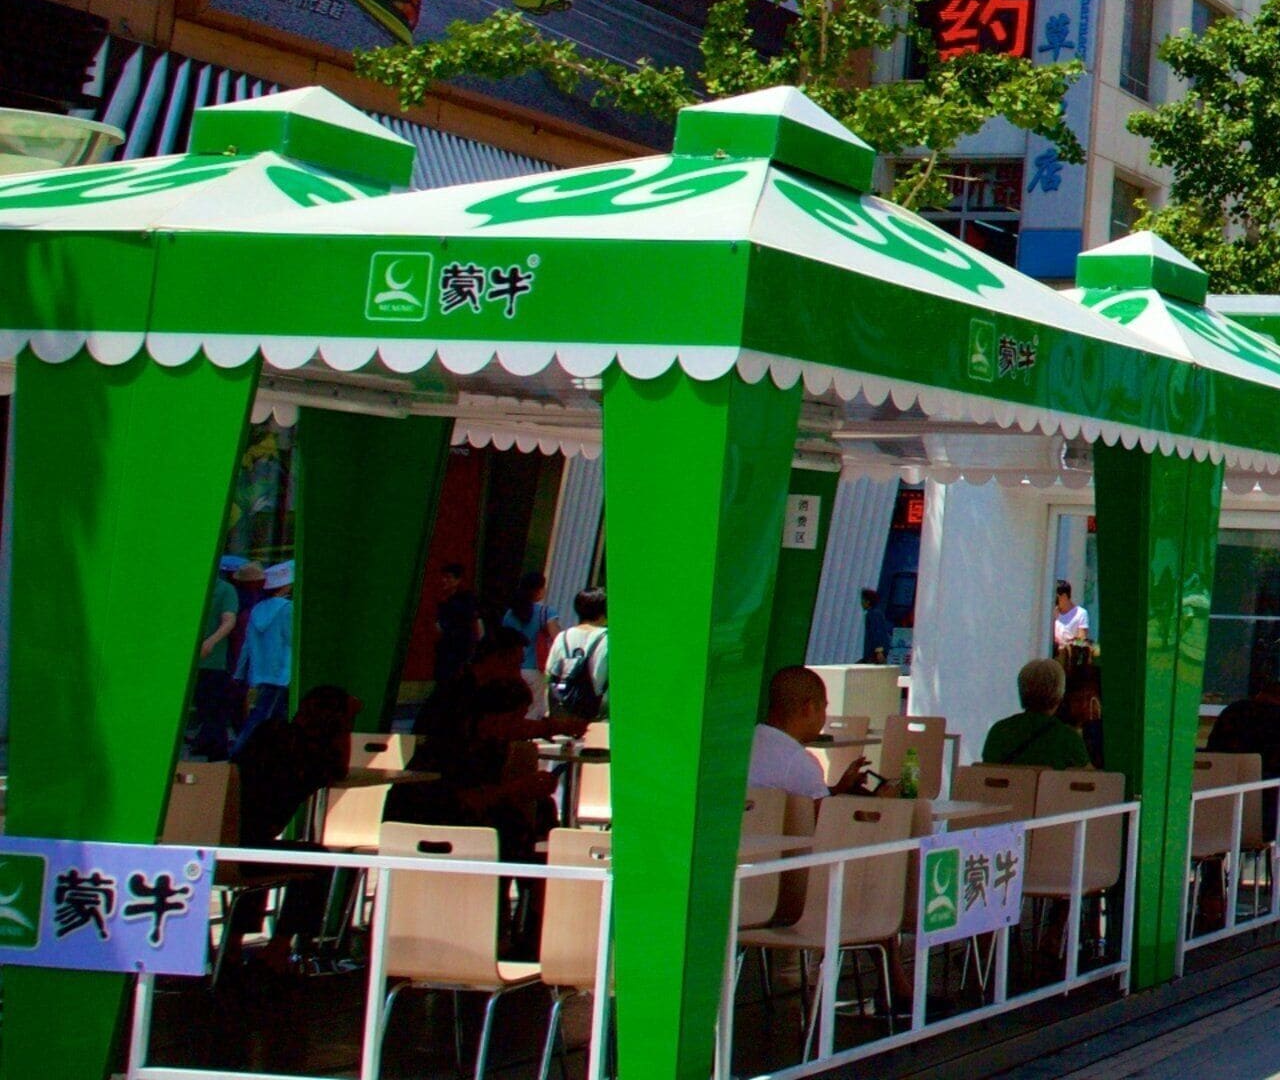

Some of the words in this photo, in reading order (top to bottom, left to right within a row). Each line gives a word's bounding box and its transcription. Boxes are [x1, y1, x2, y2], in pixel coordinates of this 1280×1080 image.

[440, 261, 535, 318] 蒙牛
[998, 335, 1037, 386] 蒙牛
[54, 869, 193, 946] 蒙牛
[963, 849, 1019, 912] 蒙牛
